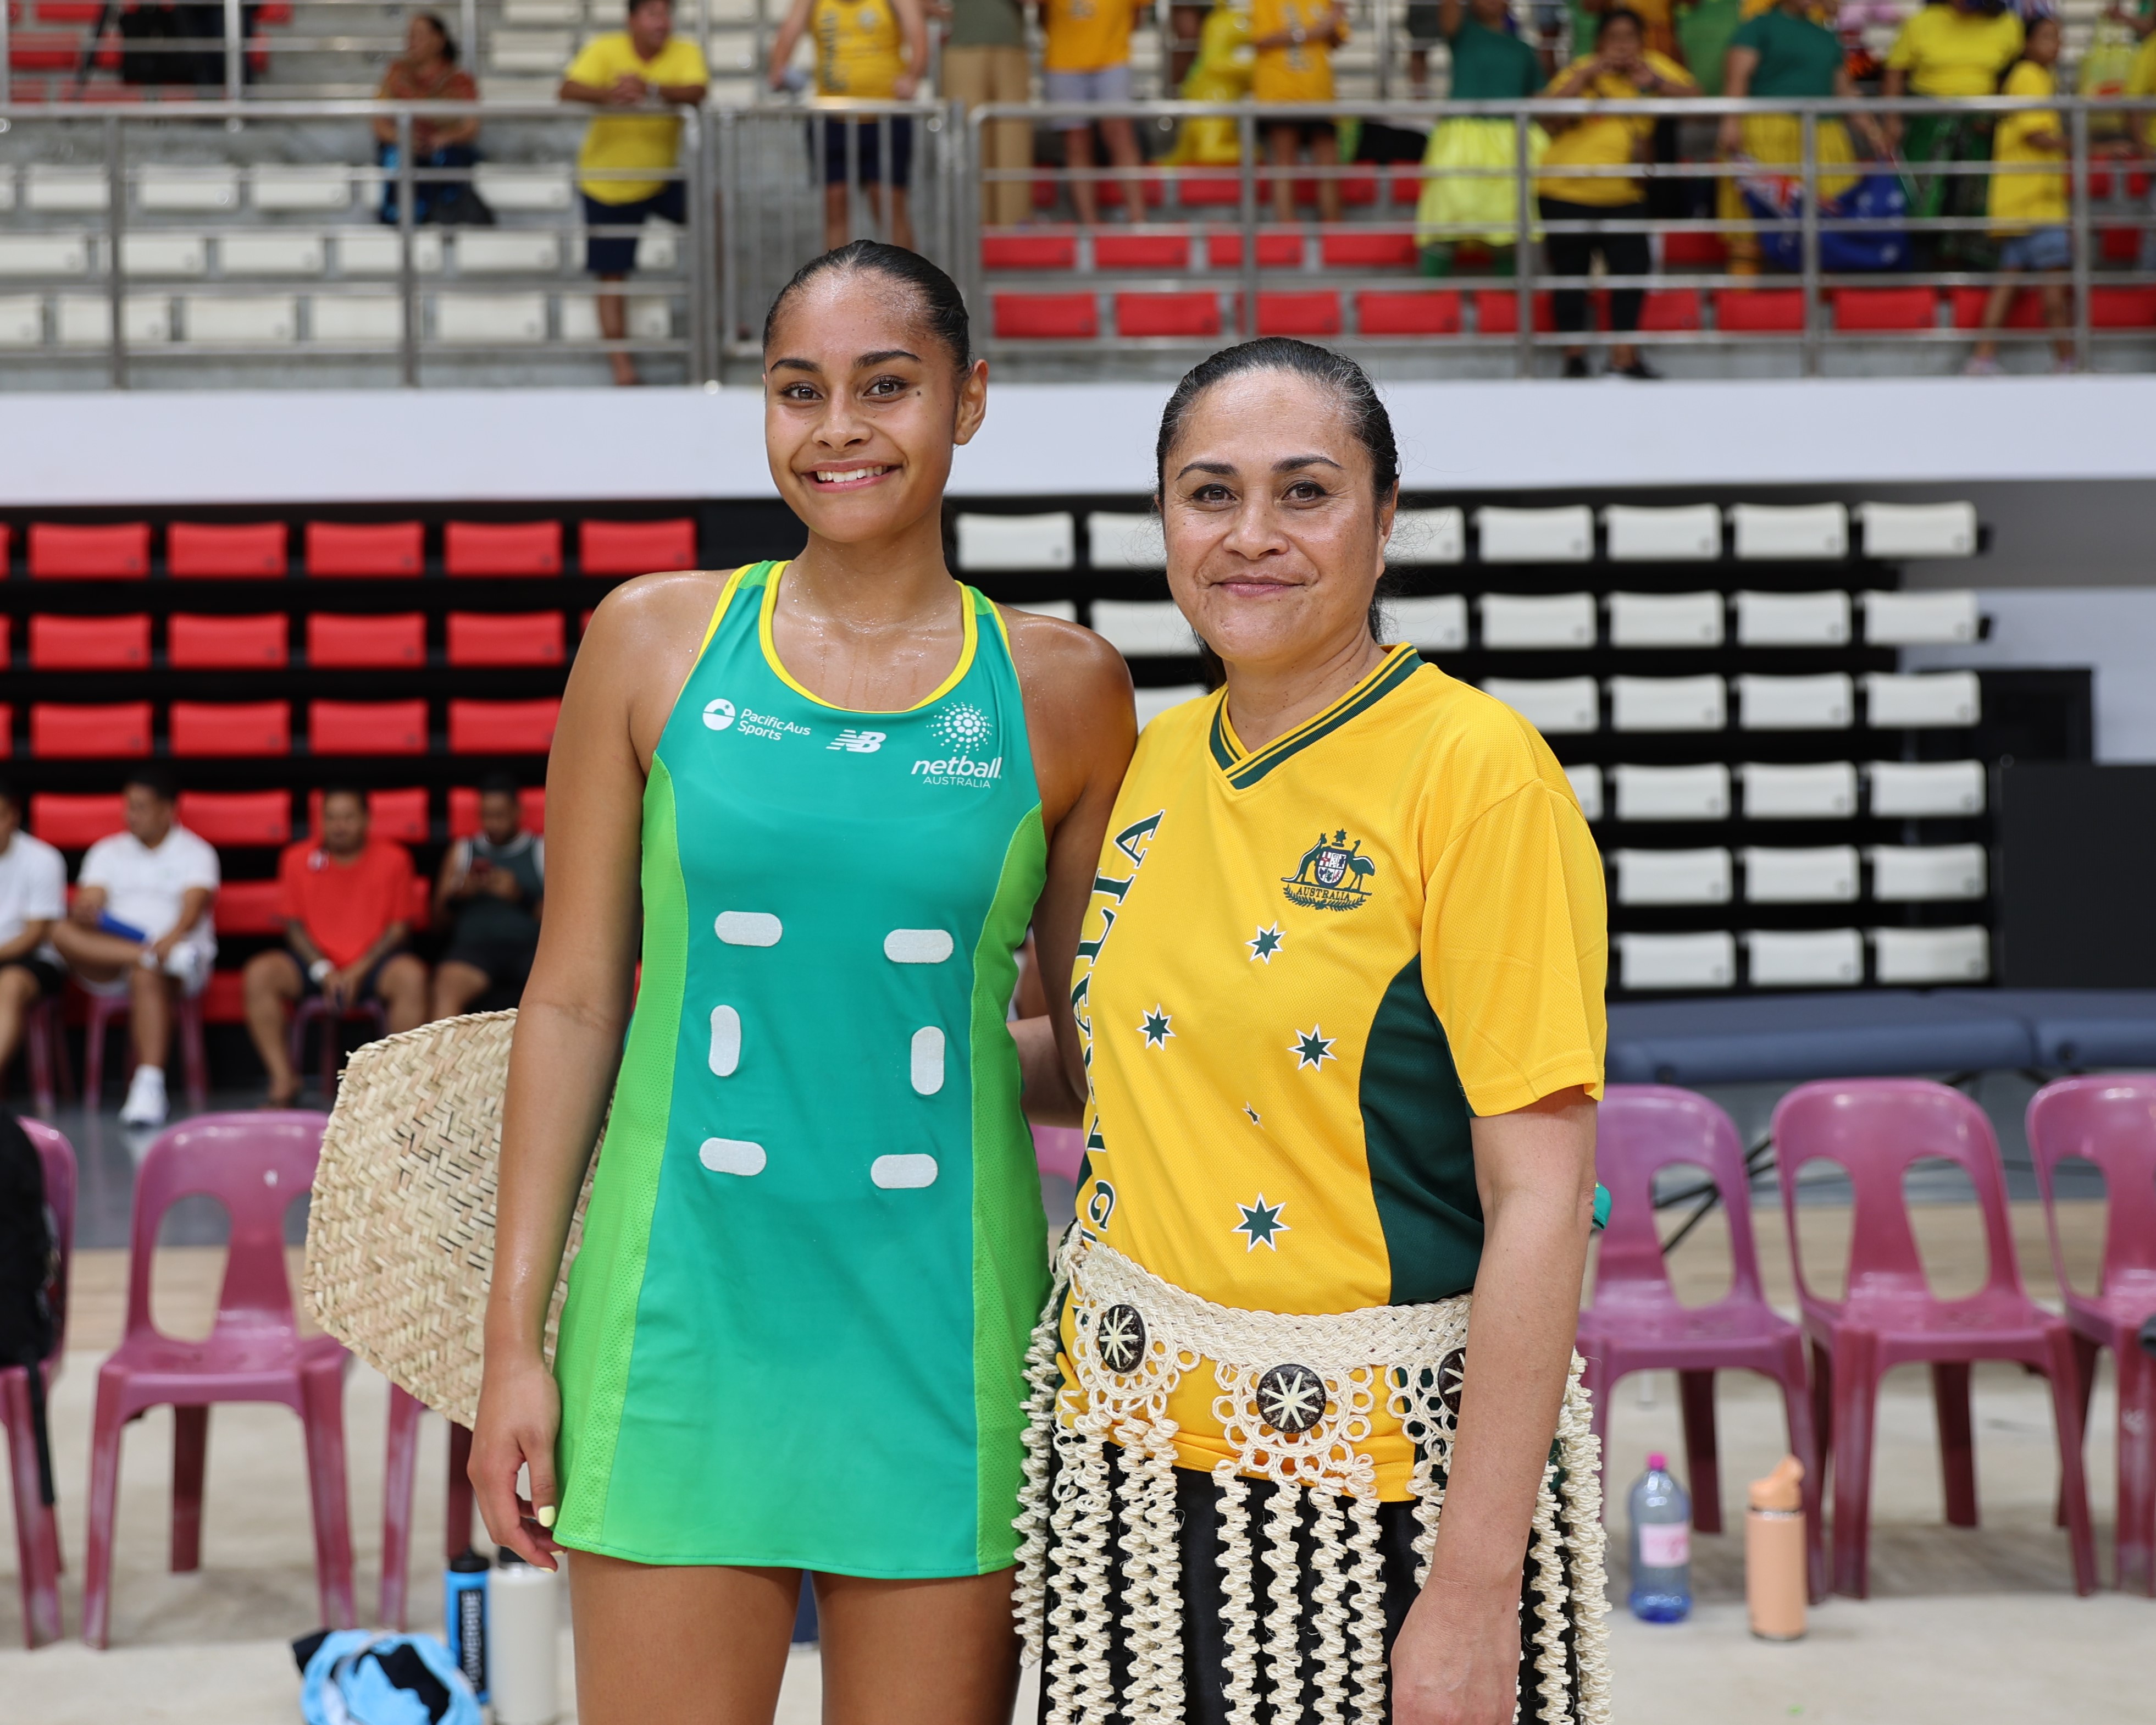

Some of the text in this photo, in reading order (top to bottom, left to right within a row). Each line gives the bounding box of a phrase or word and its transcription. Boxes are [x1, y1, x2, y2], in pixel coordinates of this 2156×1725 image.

[737, 720, 782, 740] Sports
[911, 755, 1002, 779] netball
[923, 776, 991, 788] AUSTRALIA
[1296, 886, 1350, 902] AUSTRALIA
